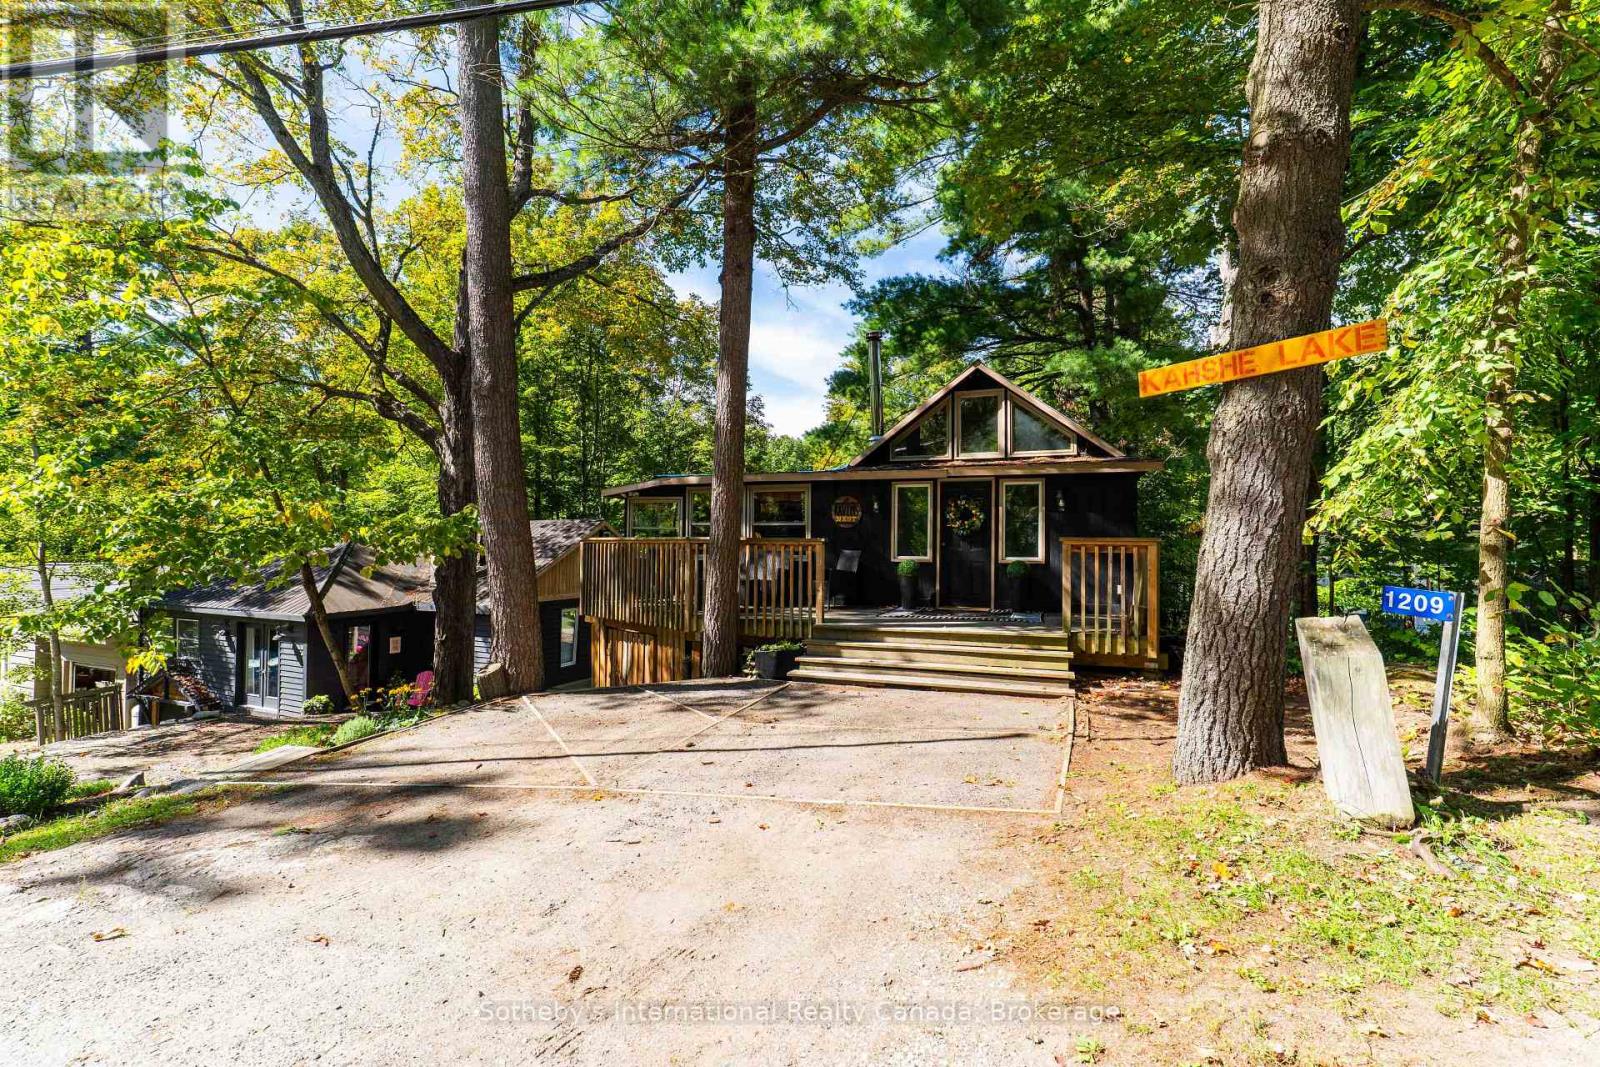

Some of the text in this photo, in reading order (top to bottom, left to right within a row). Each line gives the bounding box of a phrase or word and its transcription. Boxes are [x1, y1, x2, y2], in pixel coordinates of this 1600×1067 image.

[1141, 323, 1378, 394] KAHSHE LAKE
[1385, 590, 1444, 615] 1209
